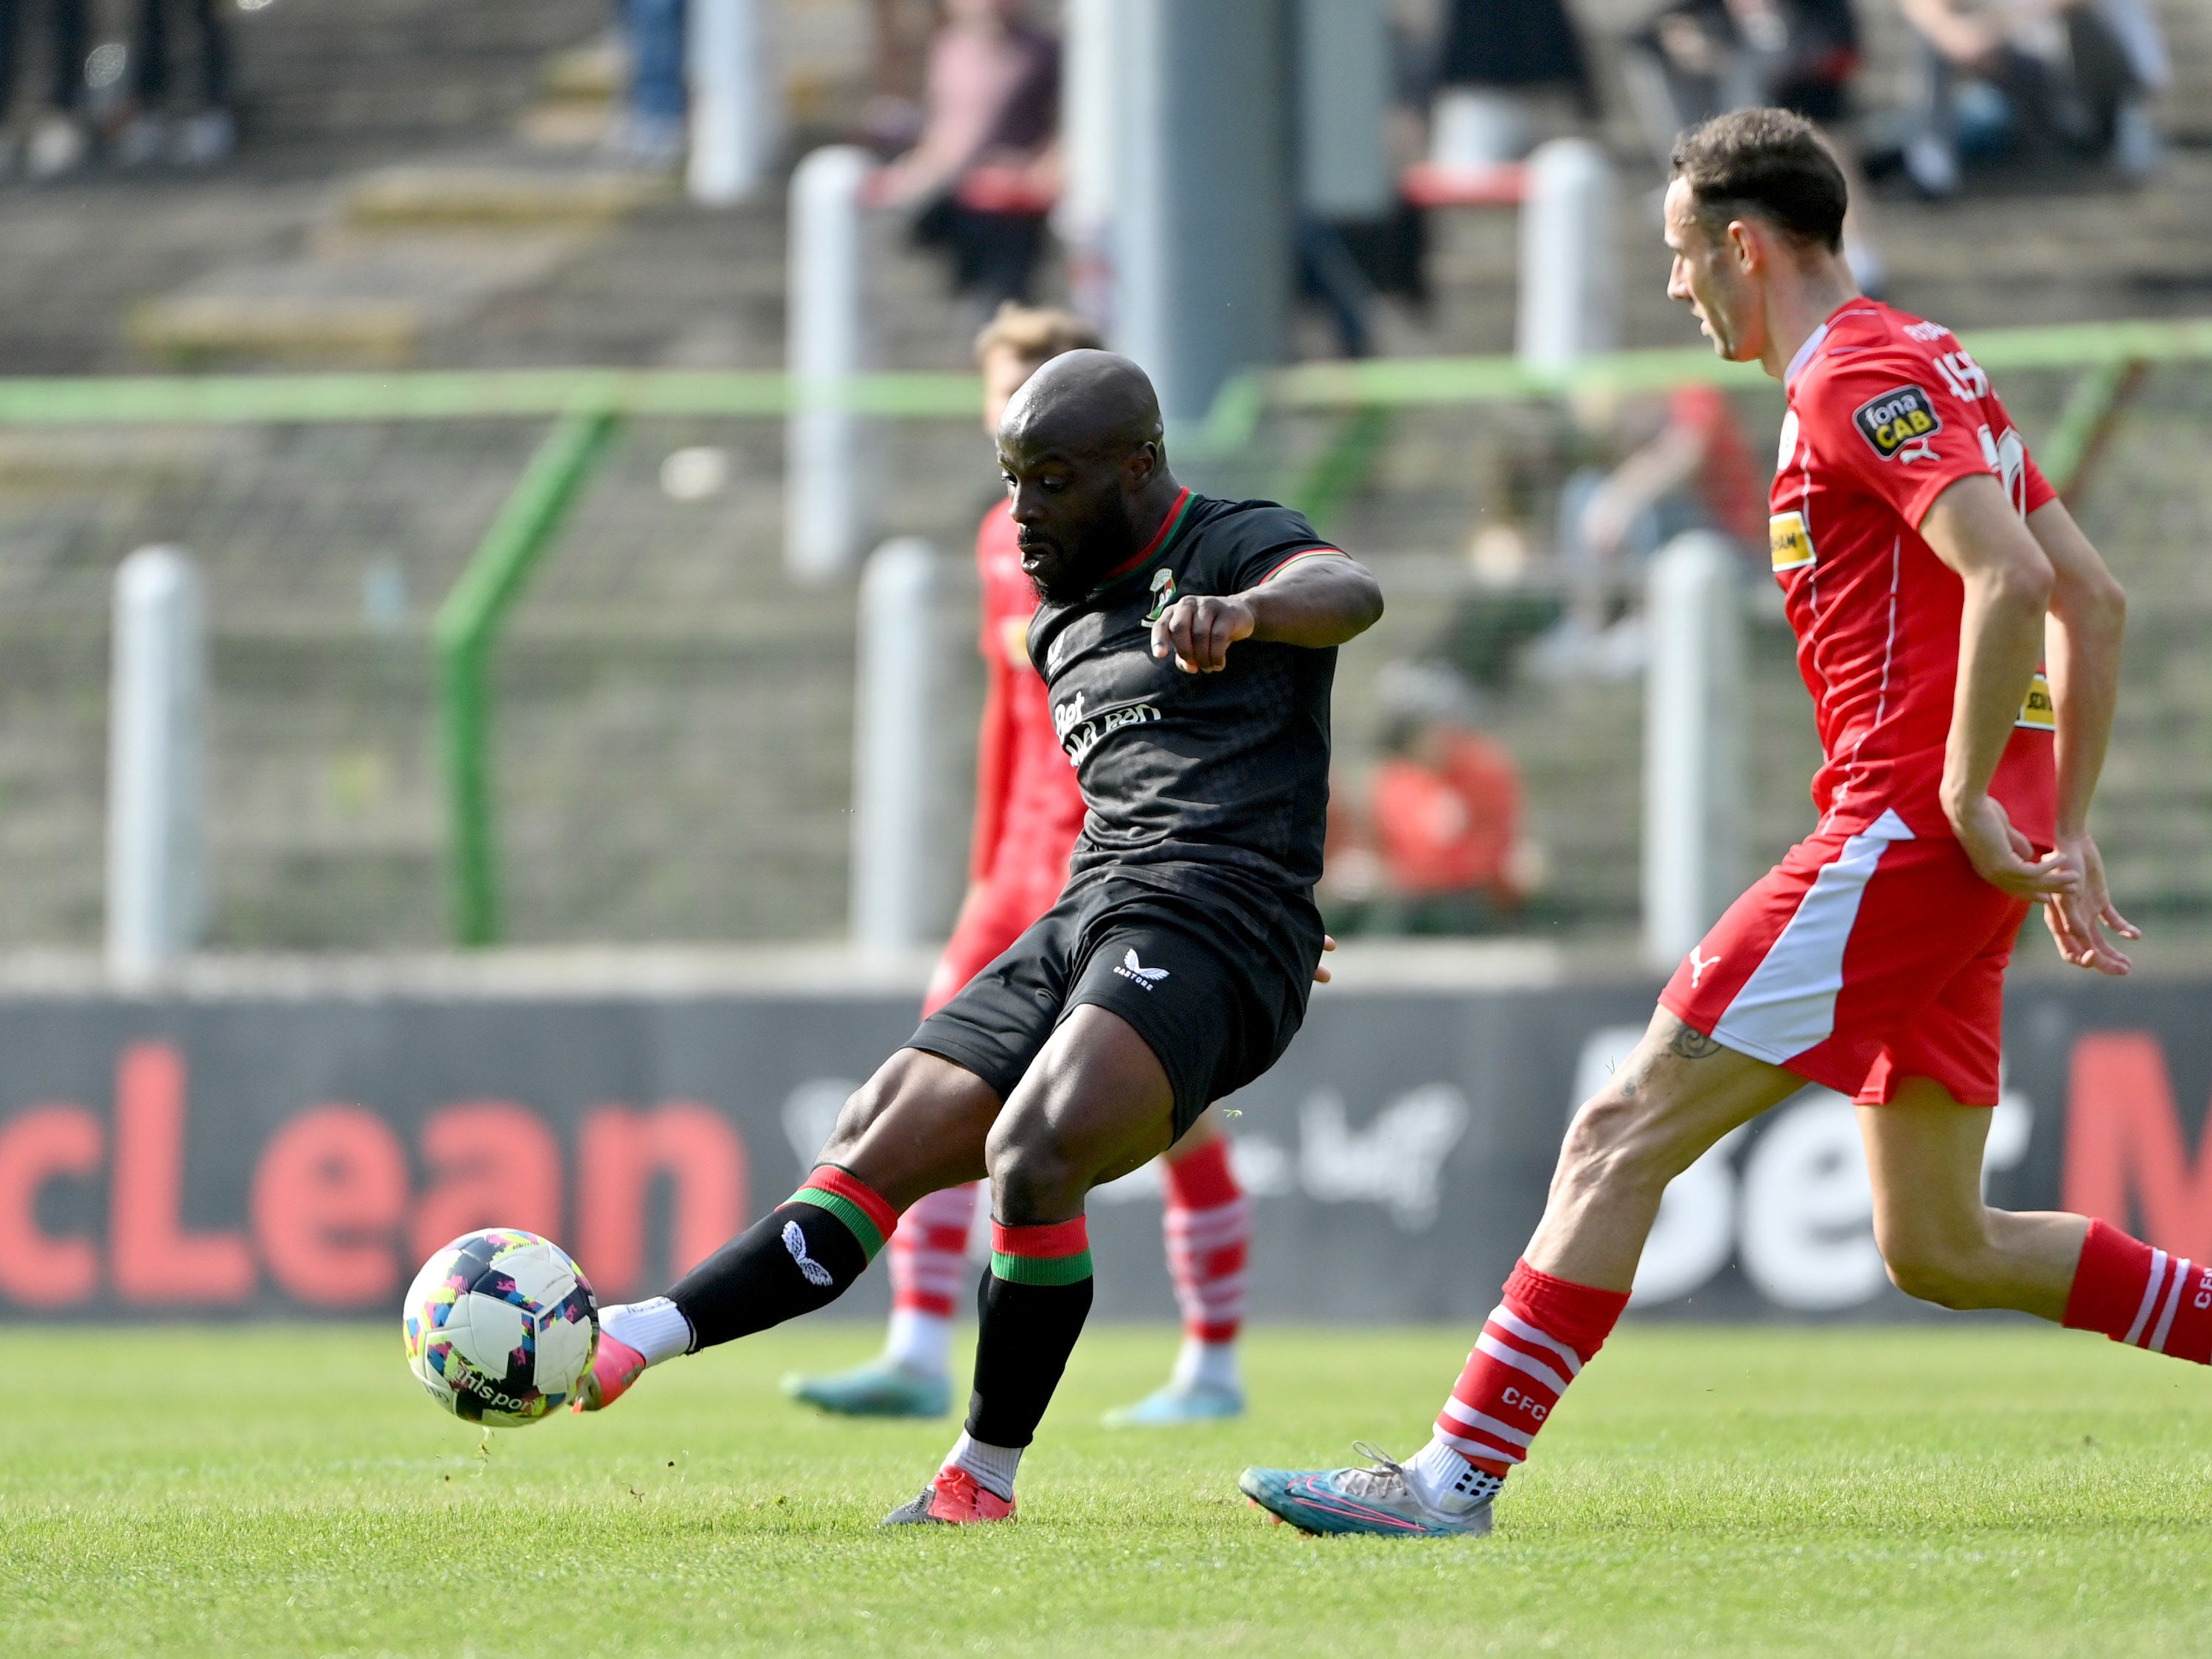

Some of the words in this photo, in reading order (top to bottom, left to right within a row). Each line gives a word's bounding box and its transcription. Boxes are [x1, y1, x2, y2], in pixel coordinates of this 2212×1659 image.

[1865, 394, 1918, 430] fona
[1876, 410, 1932, 449] CAB
[1054, 690, 1085, 746] Bet
[1113, 966, 1154, 991] CASTORE
[450, 1361, 544, 1412] hlspor
[1501, 1386, 1547, 1421] CFC
